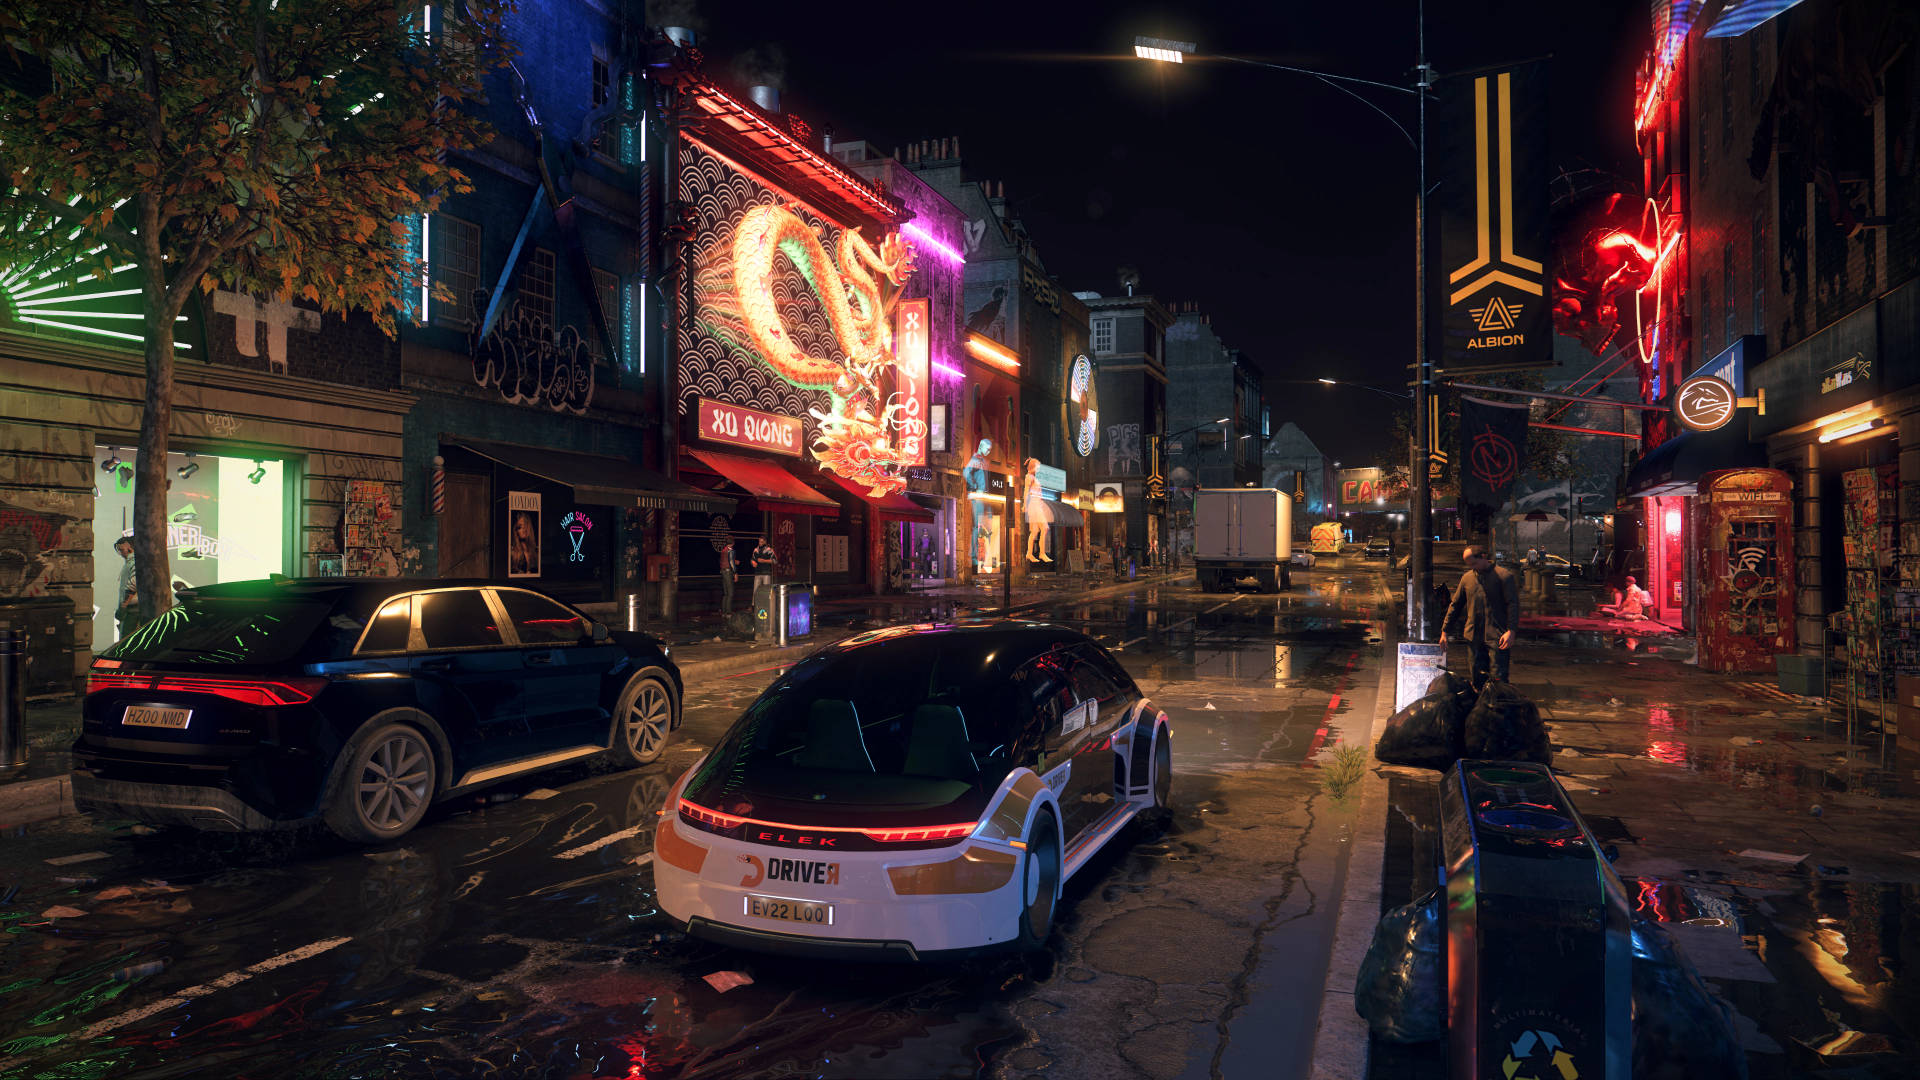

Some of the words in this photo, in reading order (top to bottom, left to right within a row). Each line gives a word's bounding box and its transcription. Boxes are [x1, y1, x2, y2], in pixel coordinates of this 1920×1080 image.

[1467, 334, 1524, 349] ALBION
[712, 409, 738, 437] XU
[744, 415, 793, 447] QIONG
[511, 495, 540, 509] LONDON
[1737, 489, 1764, 502] WIFI
[560, 512, 575, 530] HAIR
[575, 511, 593, 531] SALON
[160, 711, 185, 726] NMD
[759, 832, 838, 846] ELEK
[752, 900, 789, 919] EV22
